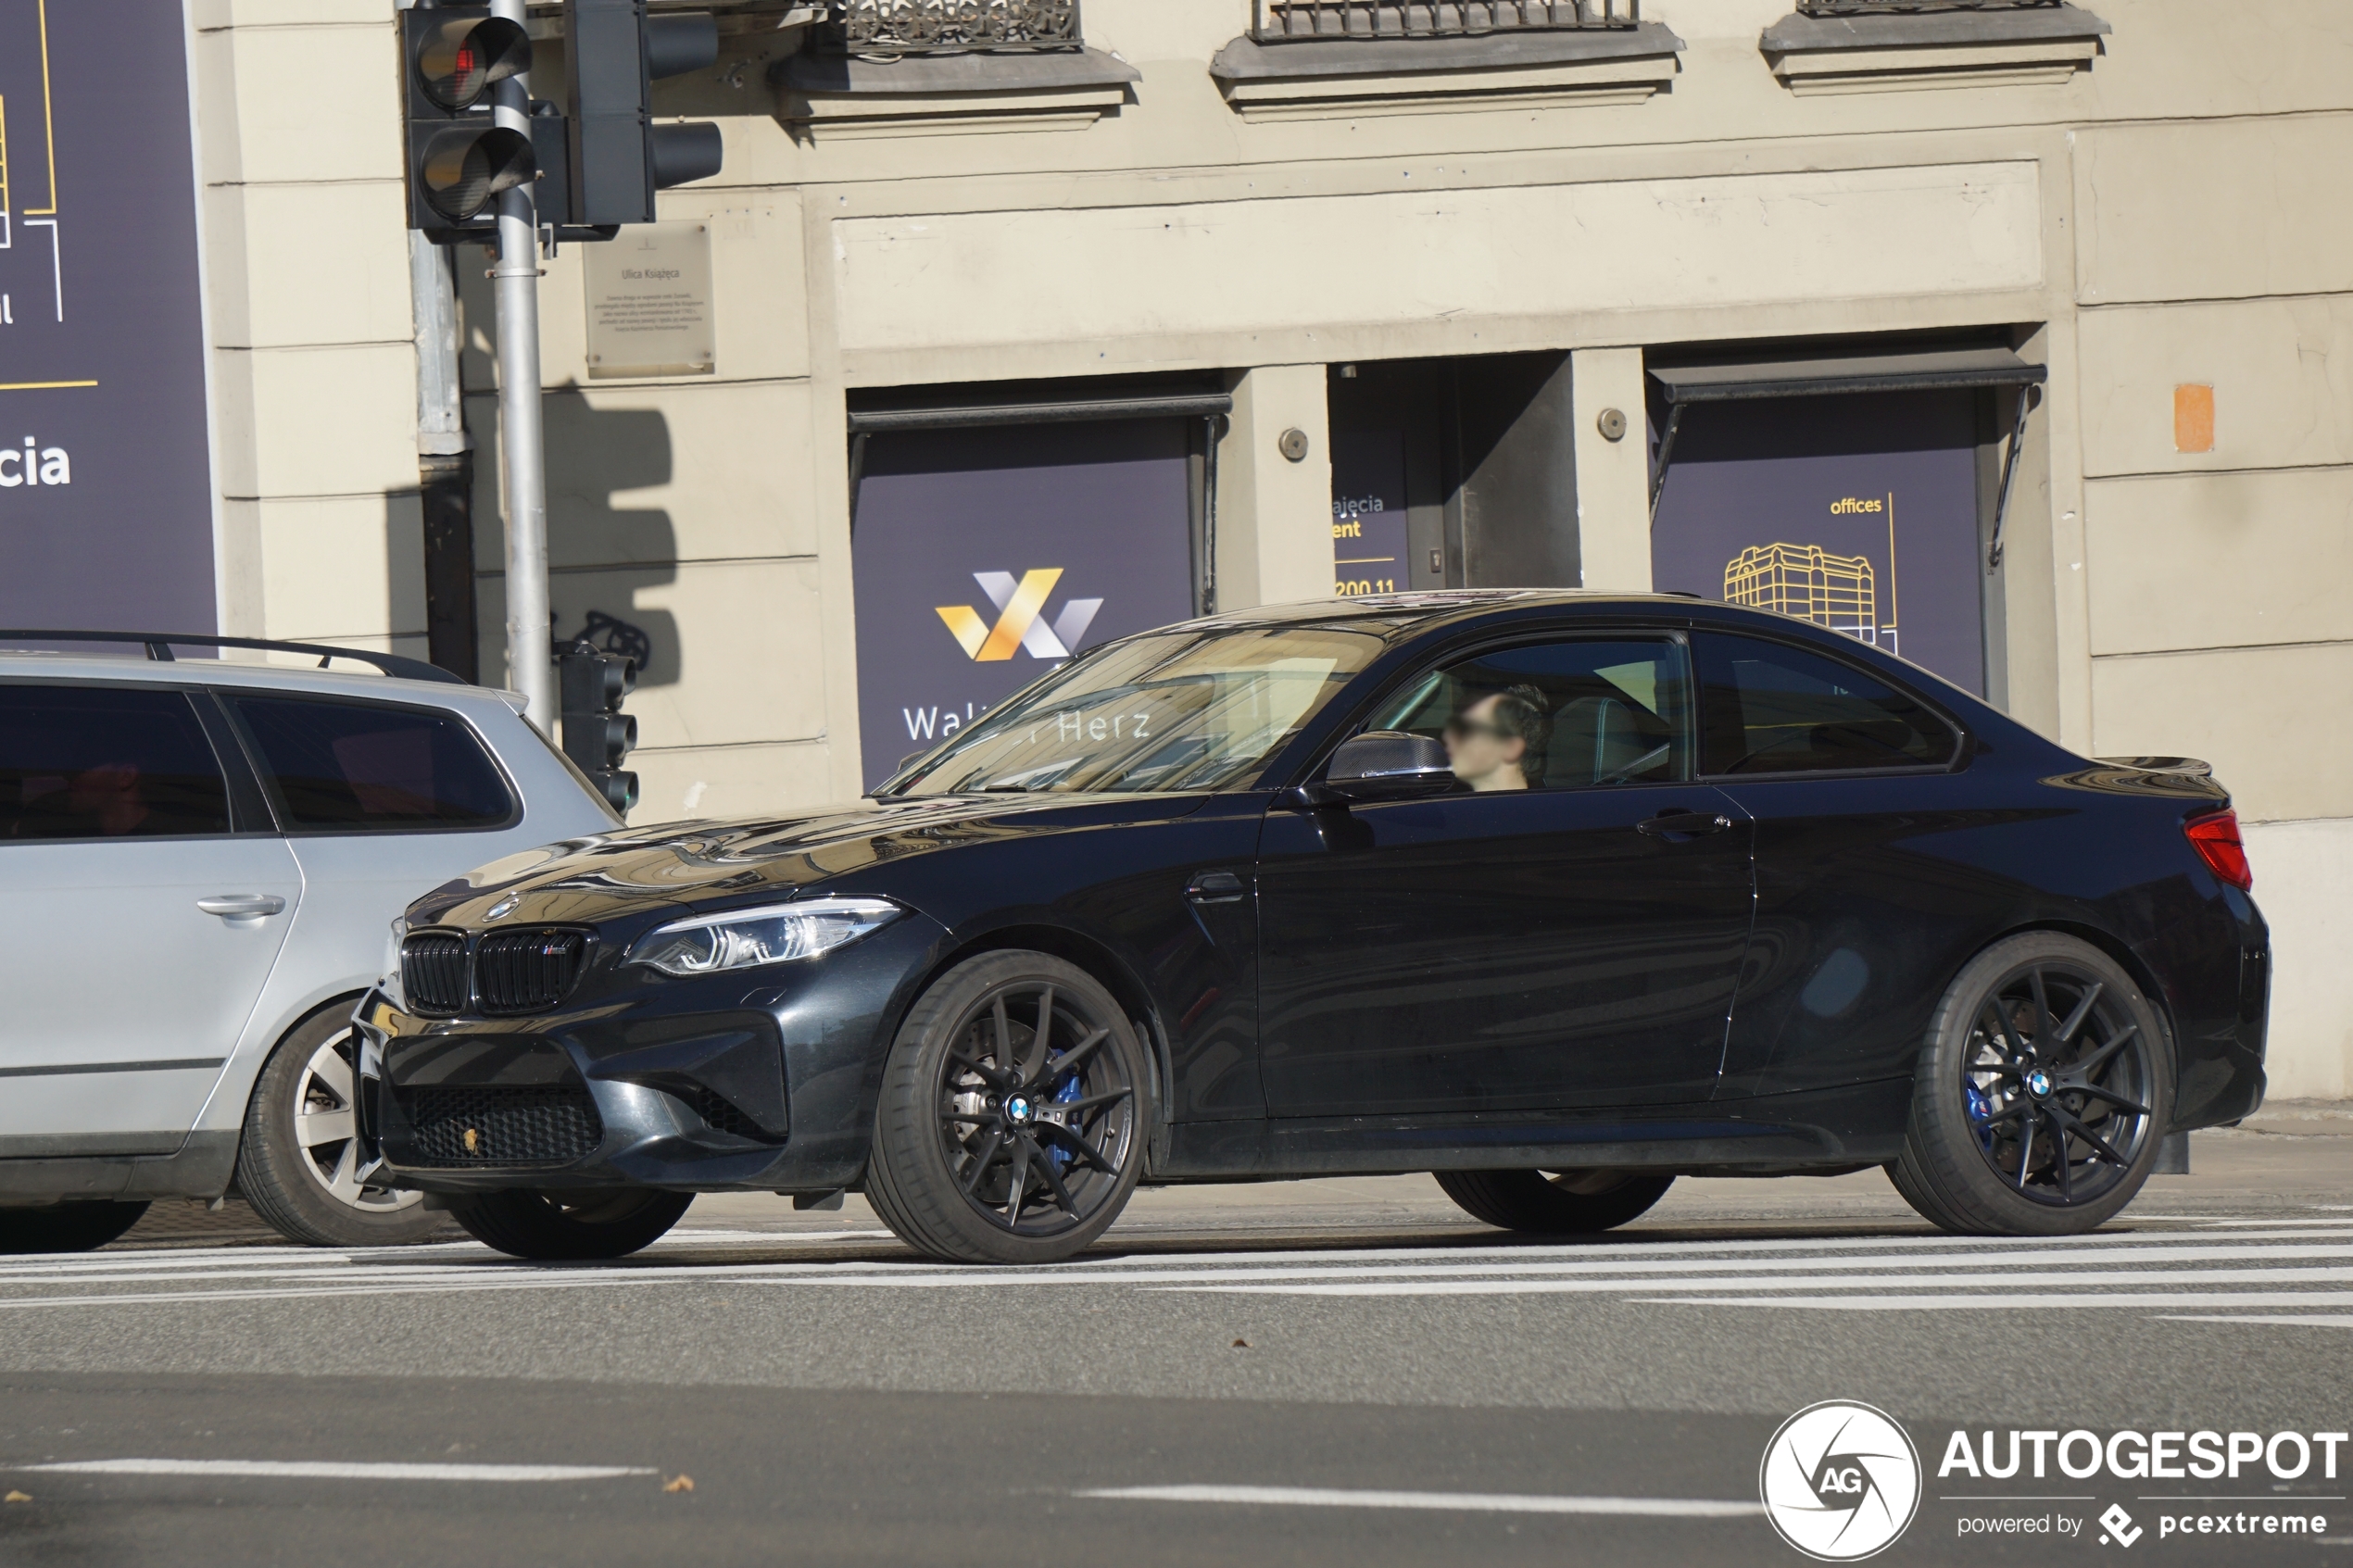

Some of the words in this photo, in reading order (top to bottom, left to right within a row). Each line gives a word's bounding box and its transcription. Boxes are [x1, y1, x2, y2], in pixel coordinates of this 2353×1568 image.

[622, 269, 643, 280] Ulica
[1830, 497, 1882, 515] offices
[1058, 710, 1151, 742] Herz
